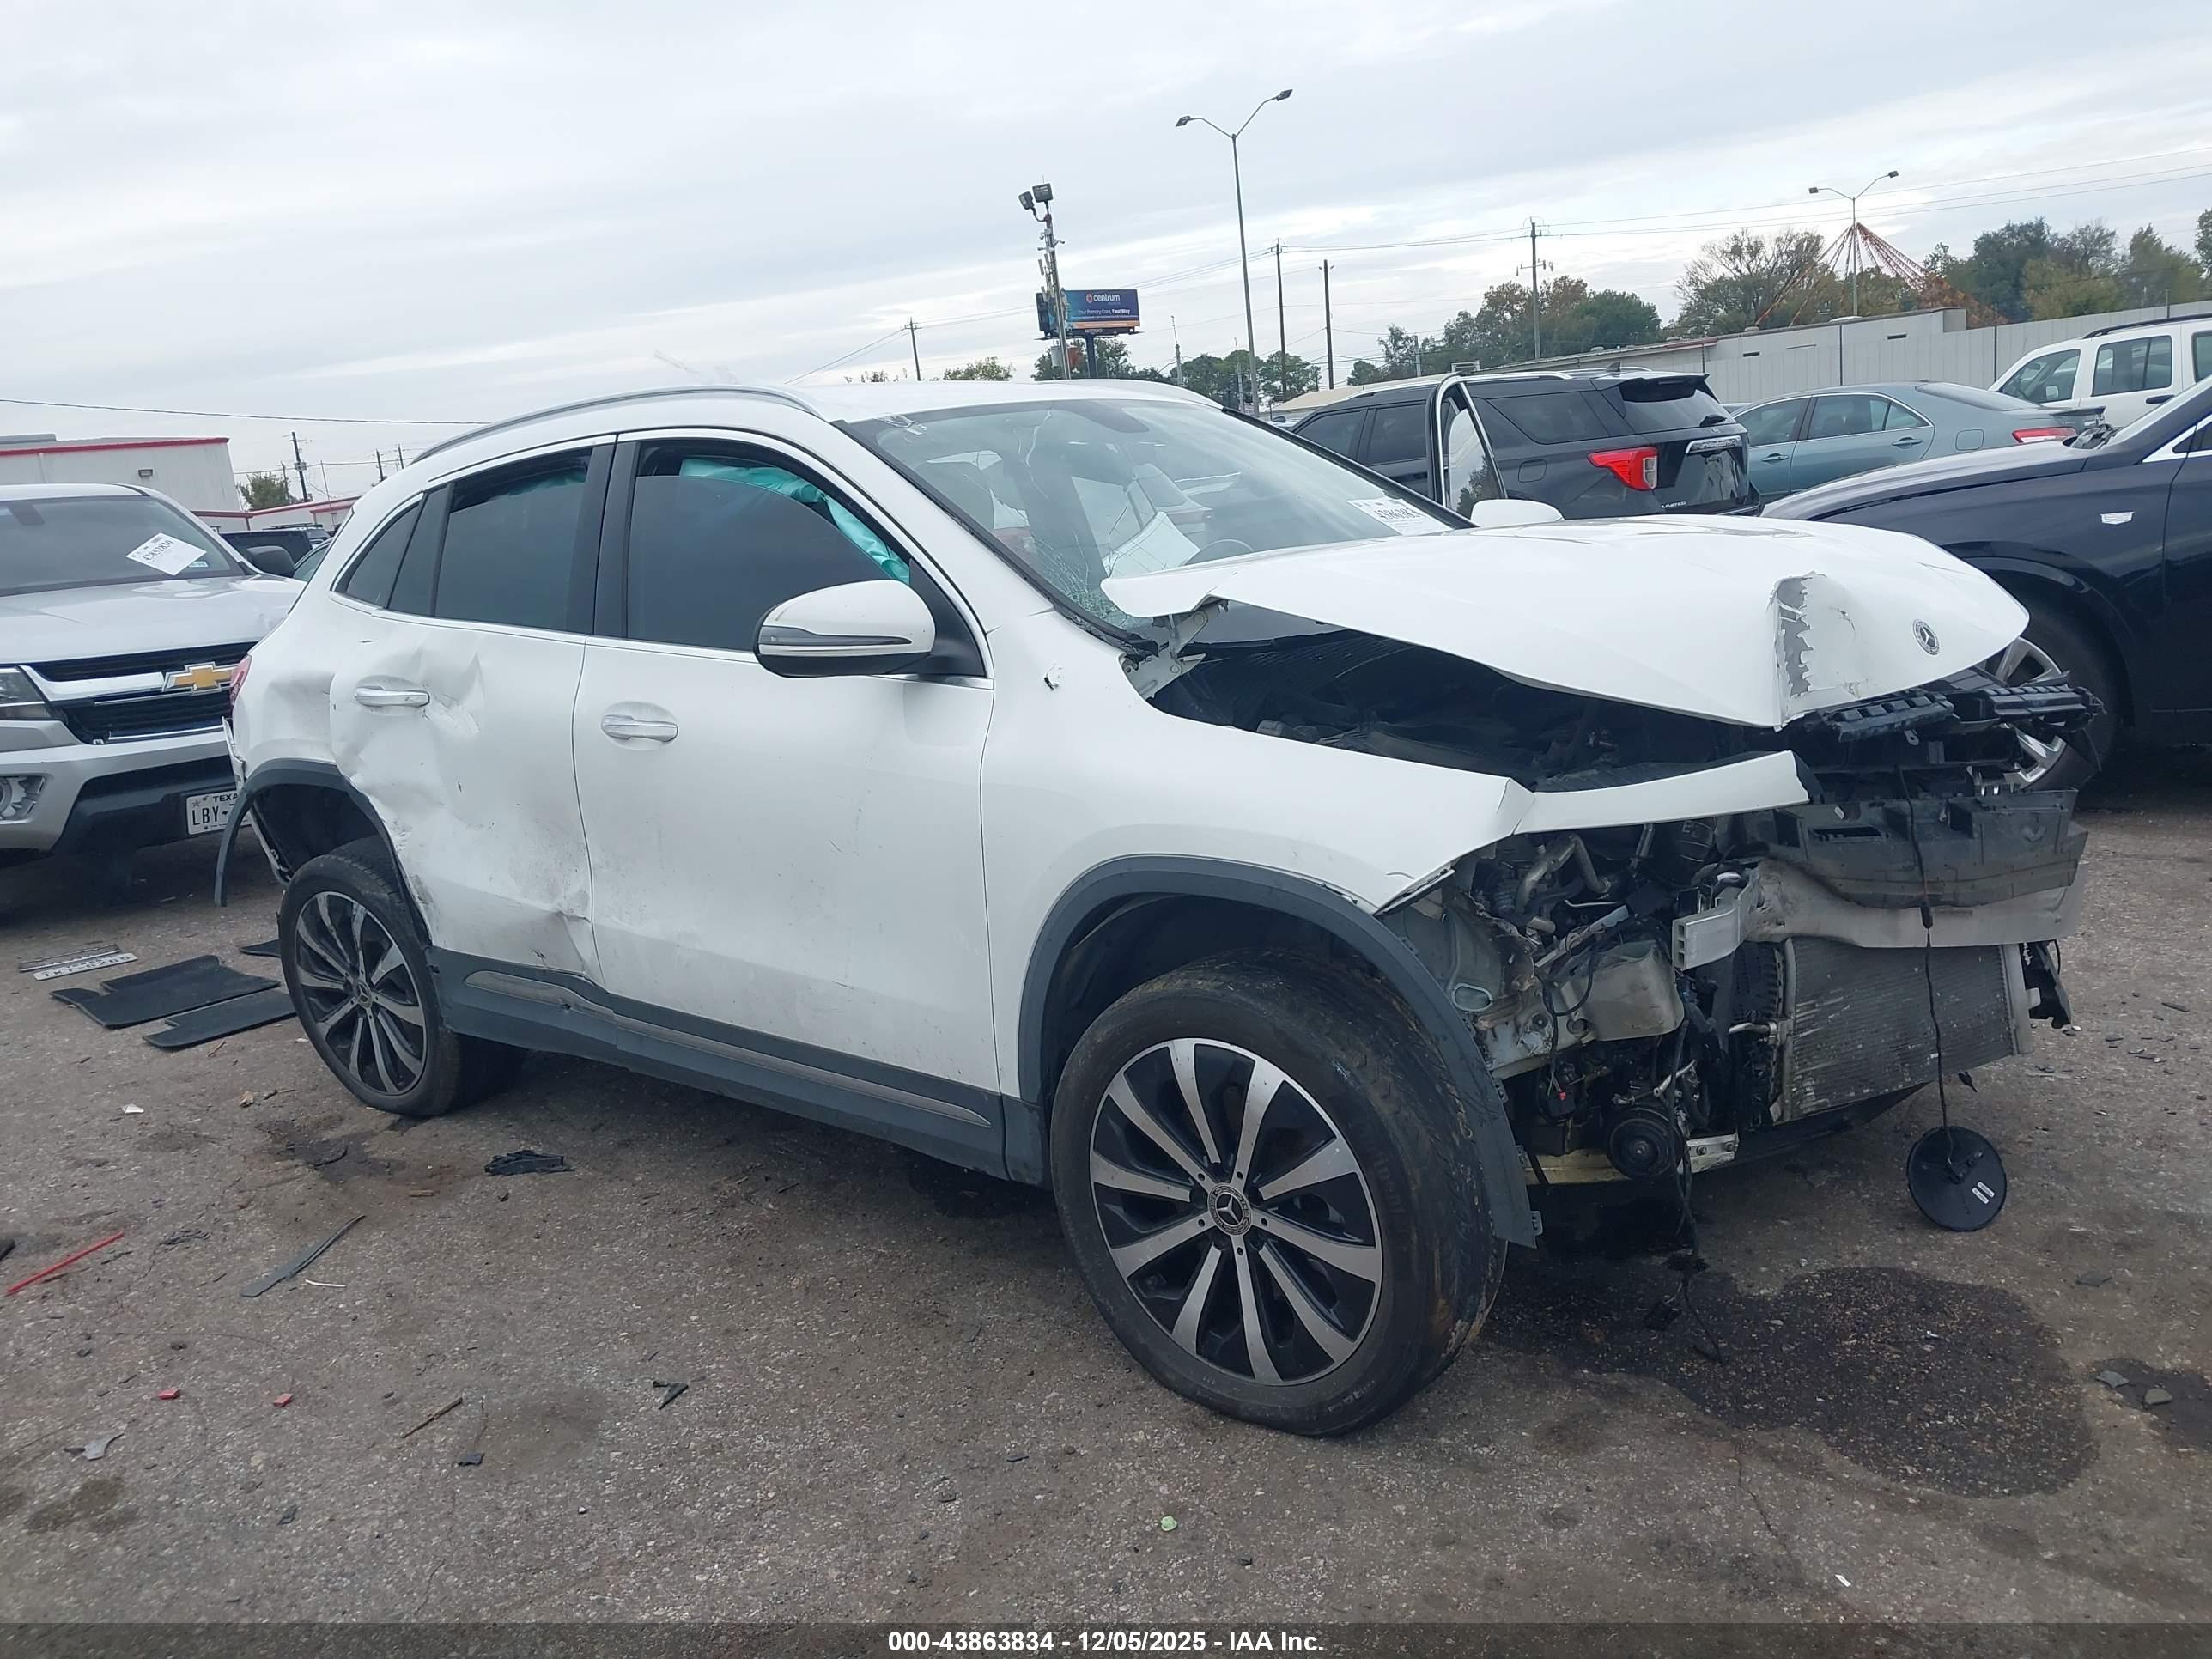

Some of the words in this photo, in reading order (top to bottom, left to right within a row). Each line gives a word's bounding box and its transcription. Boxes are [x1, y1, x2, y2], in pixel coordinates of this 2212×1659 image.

[1093, 293, 1120, 301] centrum
[213, 793, 238, 803] TEXA
[192, 805, 221, 826] LBY
